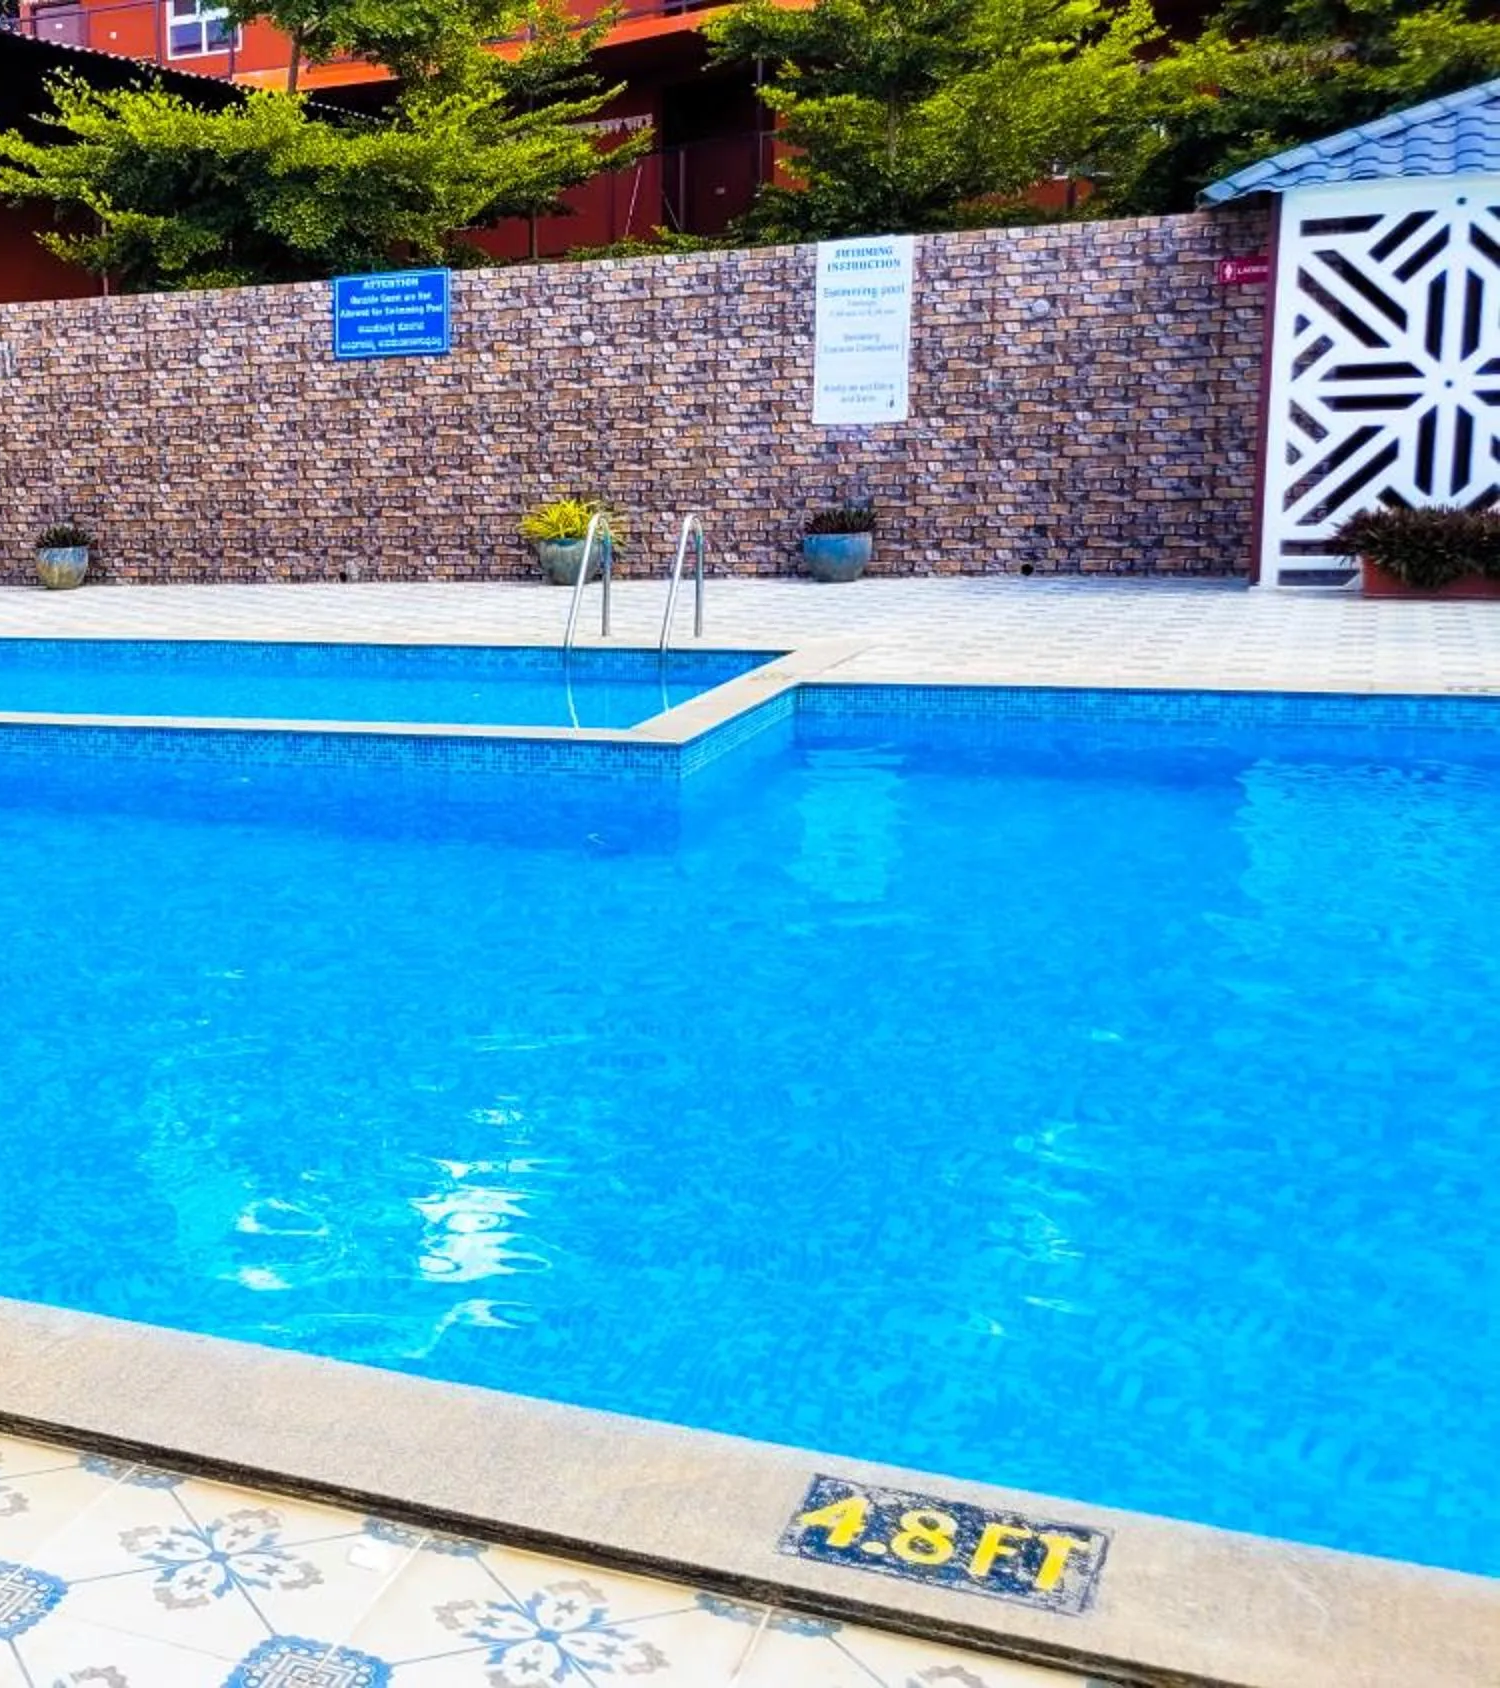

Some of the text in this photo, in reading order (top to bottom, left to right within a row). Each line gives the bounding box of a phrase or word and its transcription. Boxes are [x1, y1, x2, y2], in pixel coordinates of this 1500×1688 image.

[835, 245, 893, 259] SWIMMING
[827, 258, 900, 273] INSTRUCTION
[363, 278, 419, 290] ATTENTION
[385, 305, 425, 316] Swimming
[425, 303, 443, 313] Pool
[799, 1495, 1090, 1591] 4.8 FT
